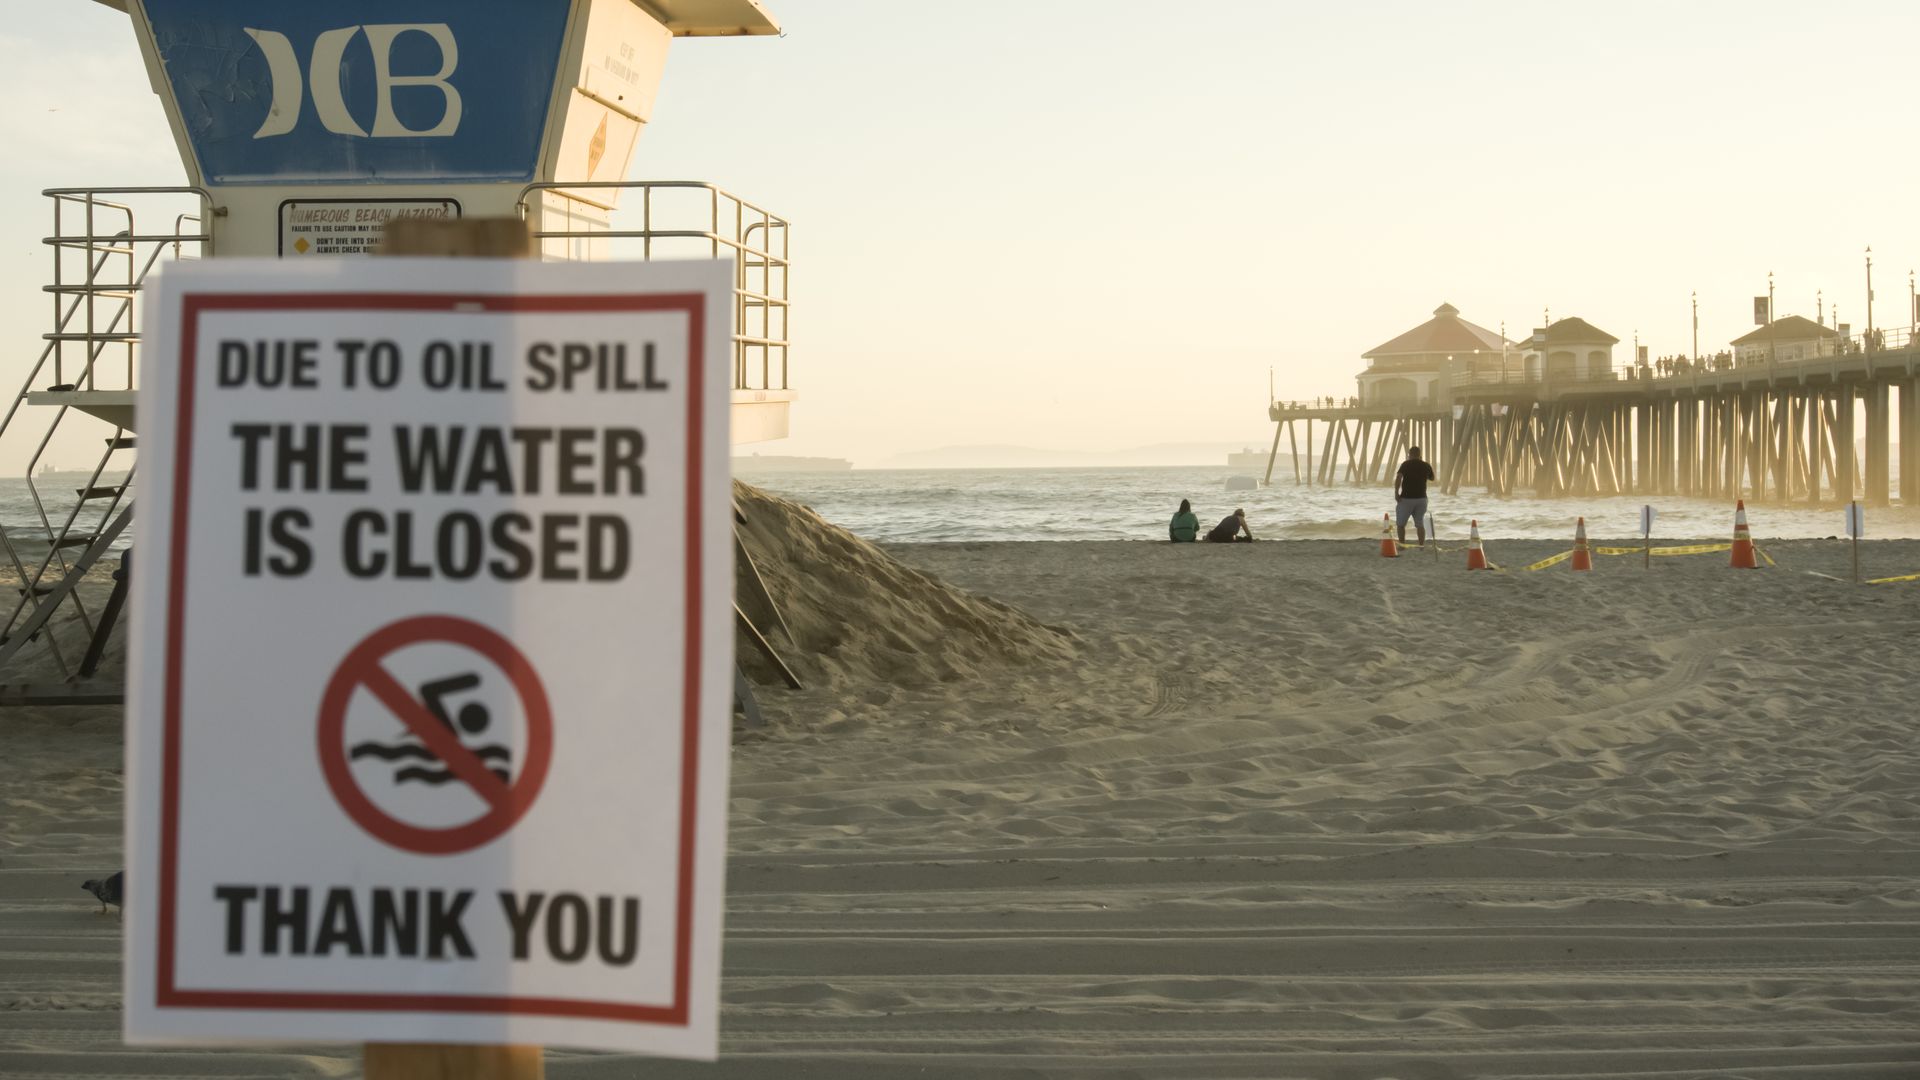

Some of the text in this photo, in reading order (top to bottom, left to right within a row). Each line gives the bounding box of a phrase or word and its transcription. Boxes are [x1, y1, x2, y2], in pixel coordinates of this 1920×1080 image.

[289, 208, 350, 223] NUMEROUS
[355, 208, 392, 222] BEACH
[316, 237, 334, 245] DON'T
[336, 237, 348, 245] DIVE
[350, 237, 364, 245] INTO
[217, 340, 668, 393] DUE TO OIL SPILL
[231, 423, 646, 496] THE WATER
[243, 507, 632, 583] IS CLOSED
[214, 885, 641, 967] THANK YOU
